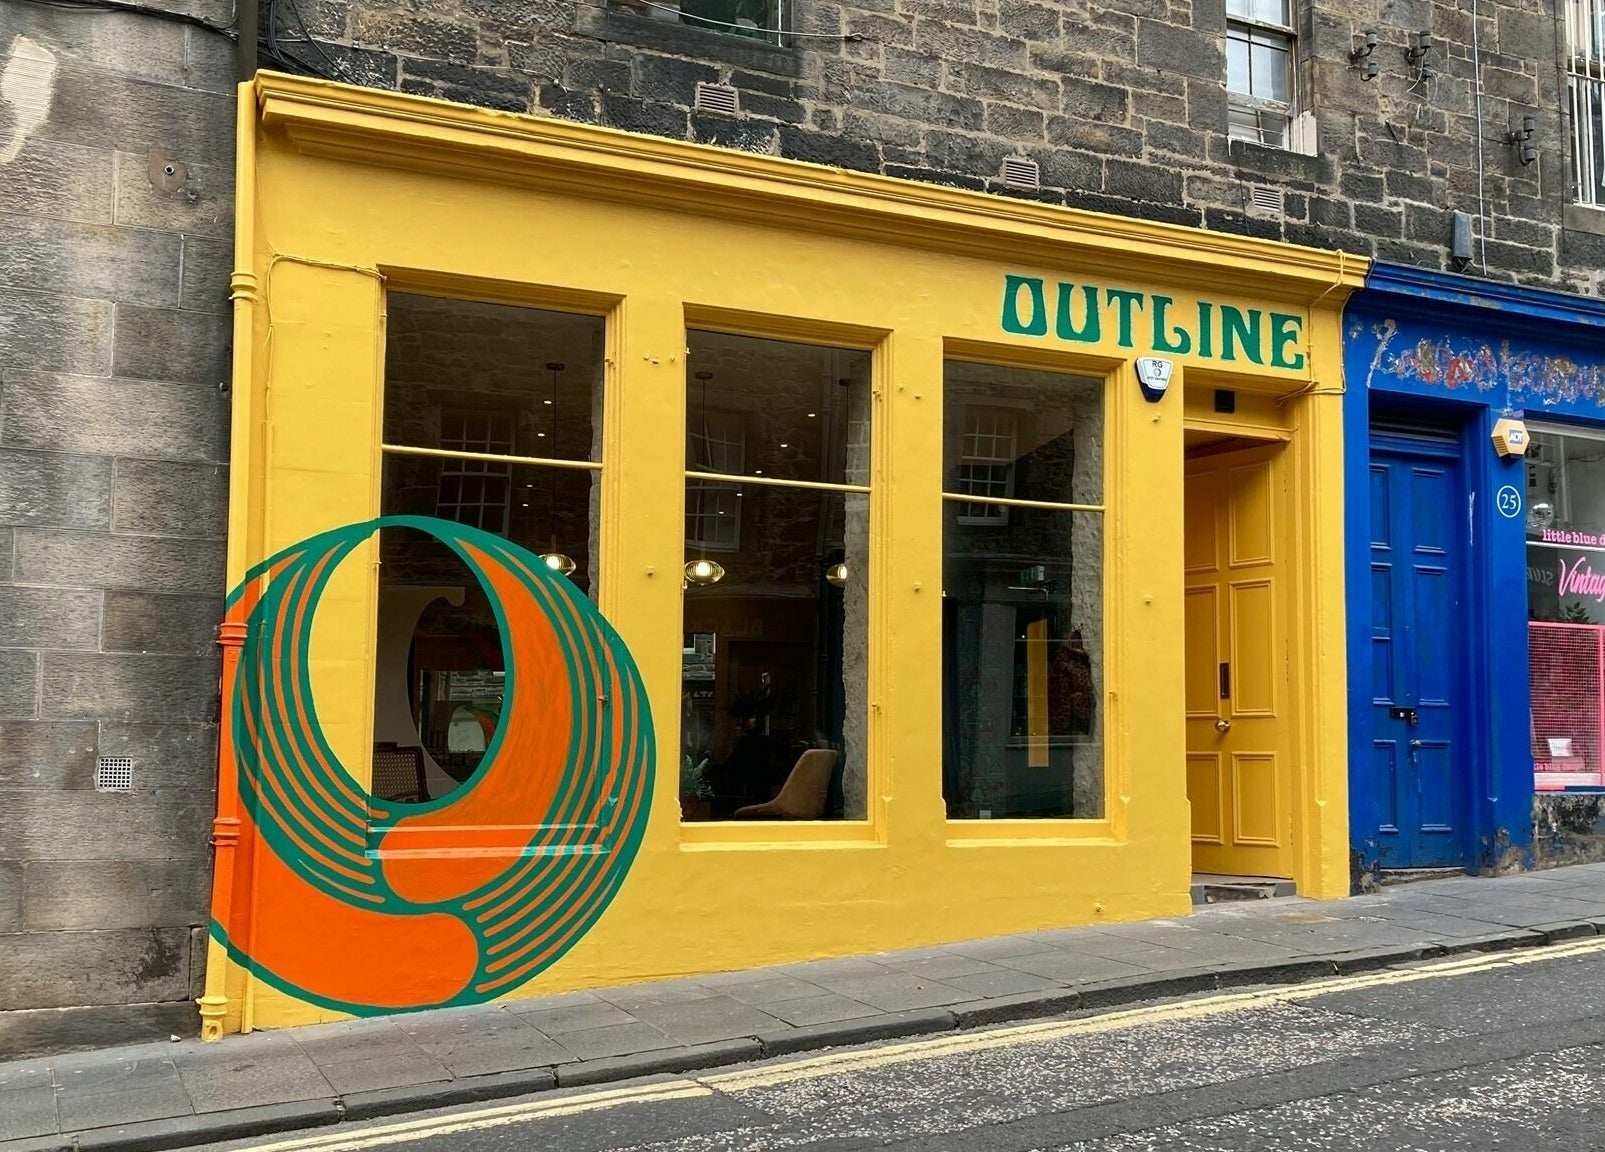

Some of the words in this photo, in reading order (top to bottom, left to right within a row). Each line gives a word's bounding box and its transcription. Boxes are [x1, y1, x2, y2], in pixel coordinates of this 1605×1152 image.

[1002, 275, 1304, 369] OUTLINE
[1152, 360, 1163, 368] RG
[1501, 493, 1517, 510] 25
[1542, 529, 1571, 543] little
[1572, 532, 1597, 544] blue
